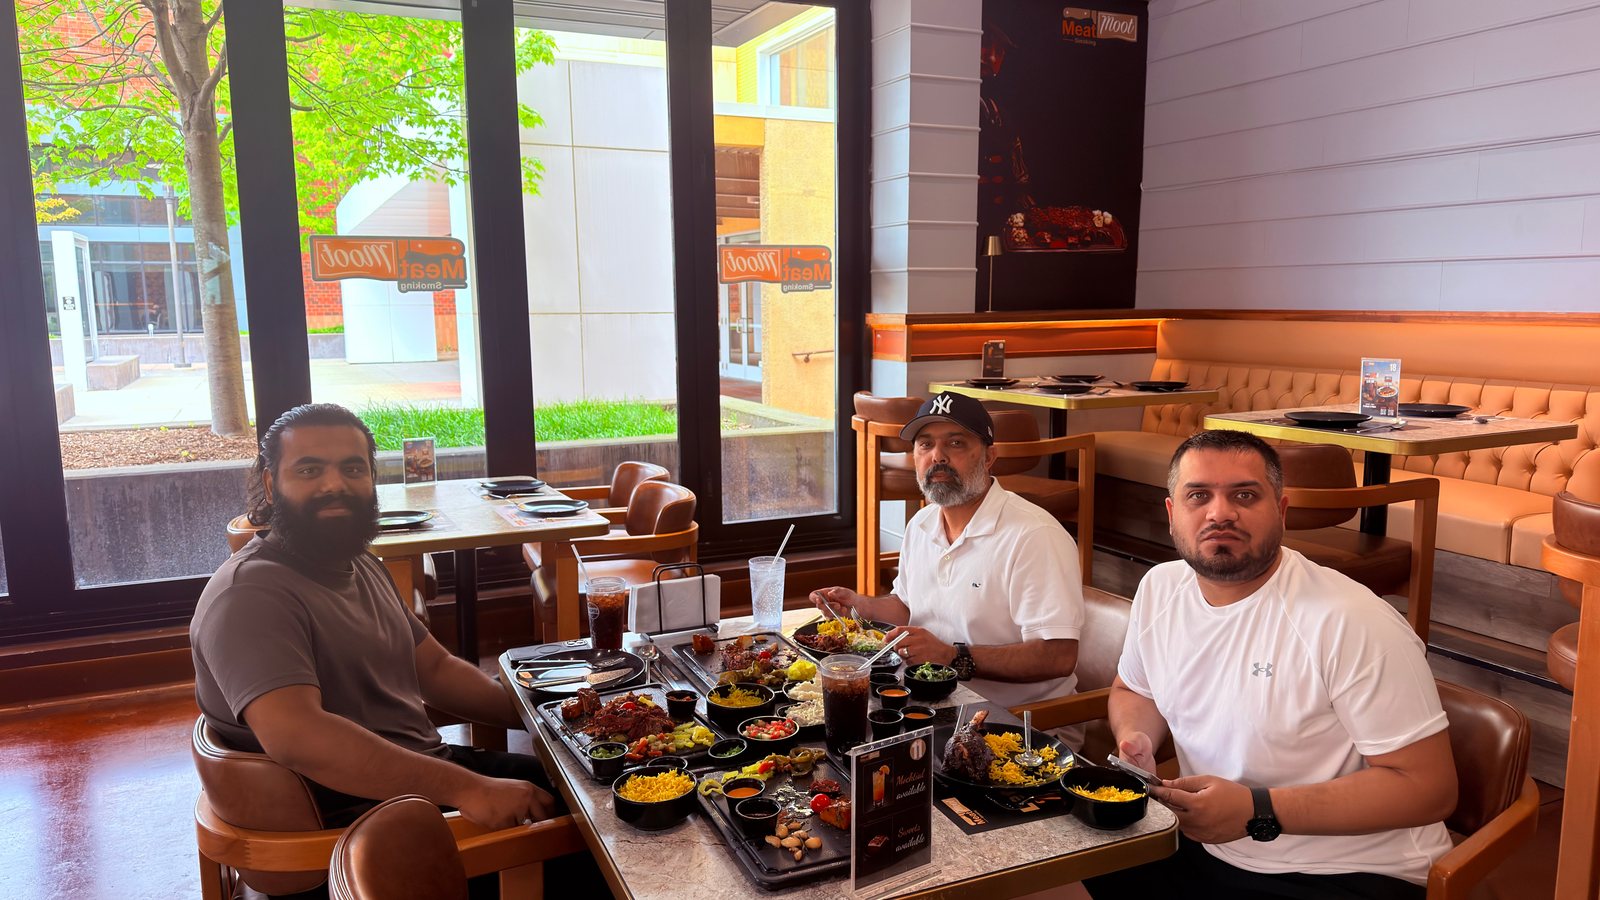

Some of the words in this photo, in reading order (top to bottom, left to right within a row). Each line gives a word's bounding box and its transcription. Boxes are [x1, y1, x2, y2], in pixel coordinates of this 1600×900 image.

[1062, 20, 1097, 38] Meat
[1100, 15, 1135, 35] Moot
[929, 394, 954, 414] NY
[896, 782, 926, 800] available
[895, 833, 925, 852] available
